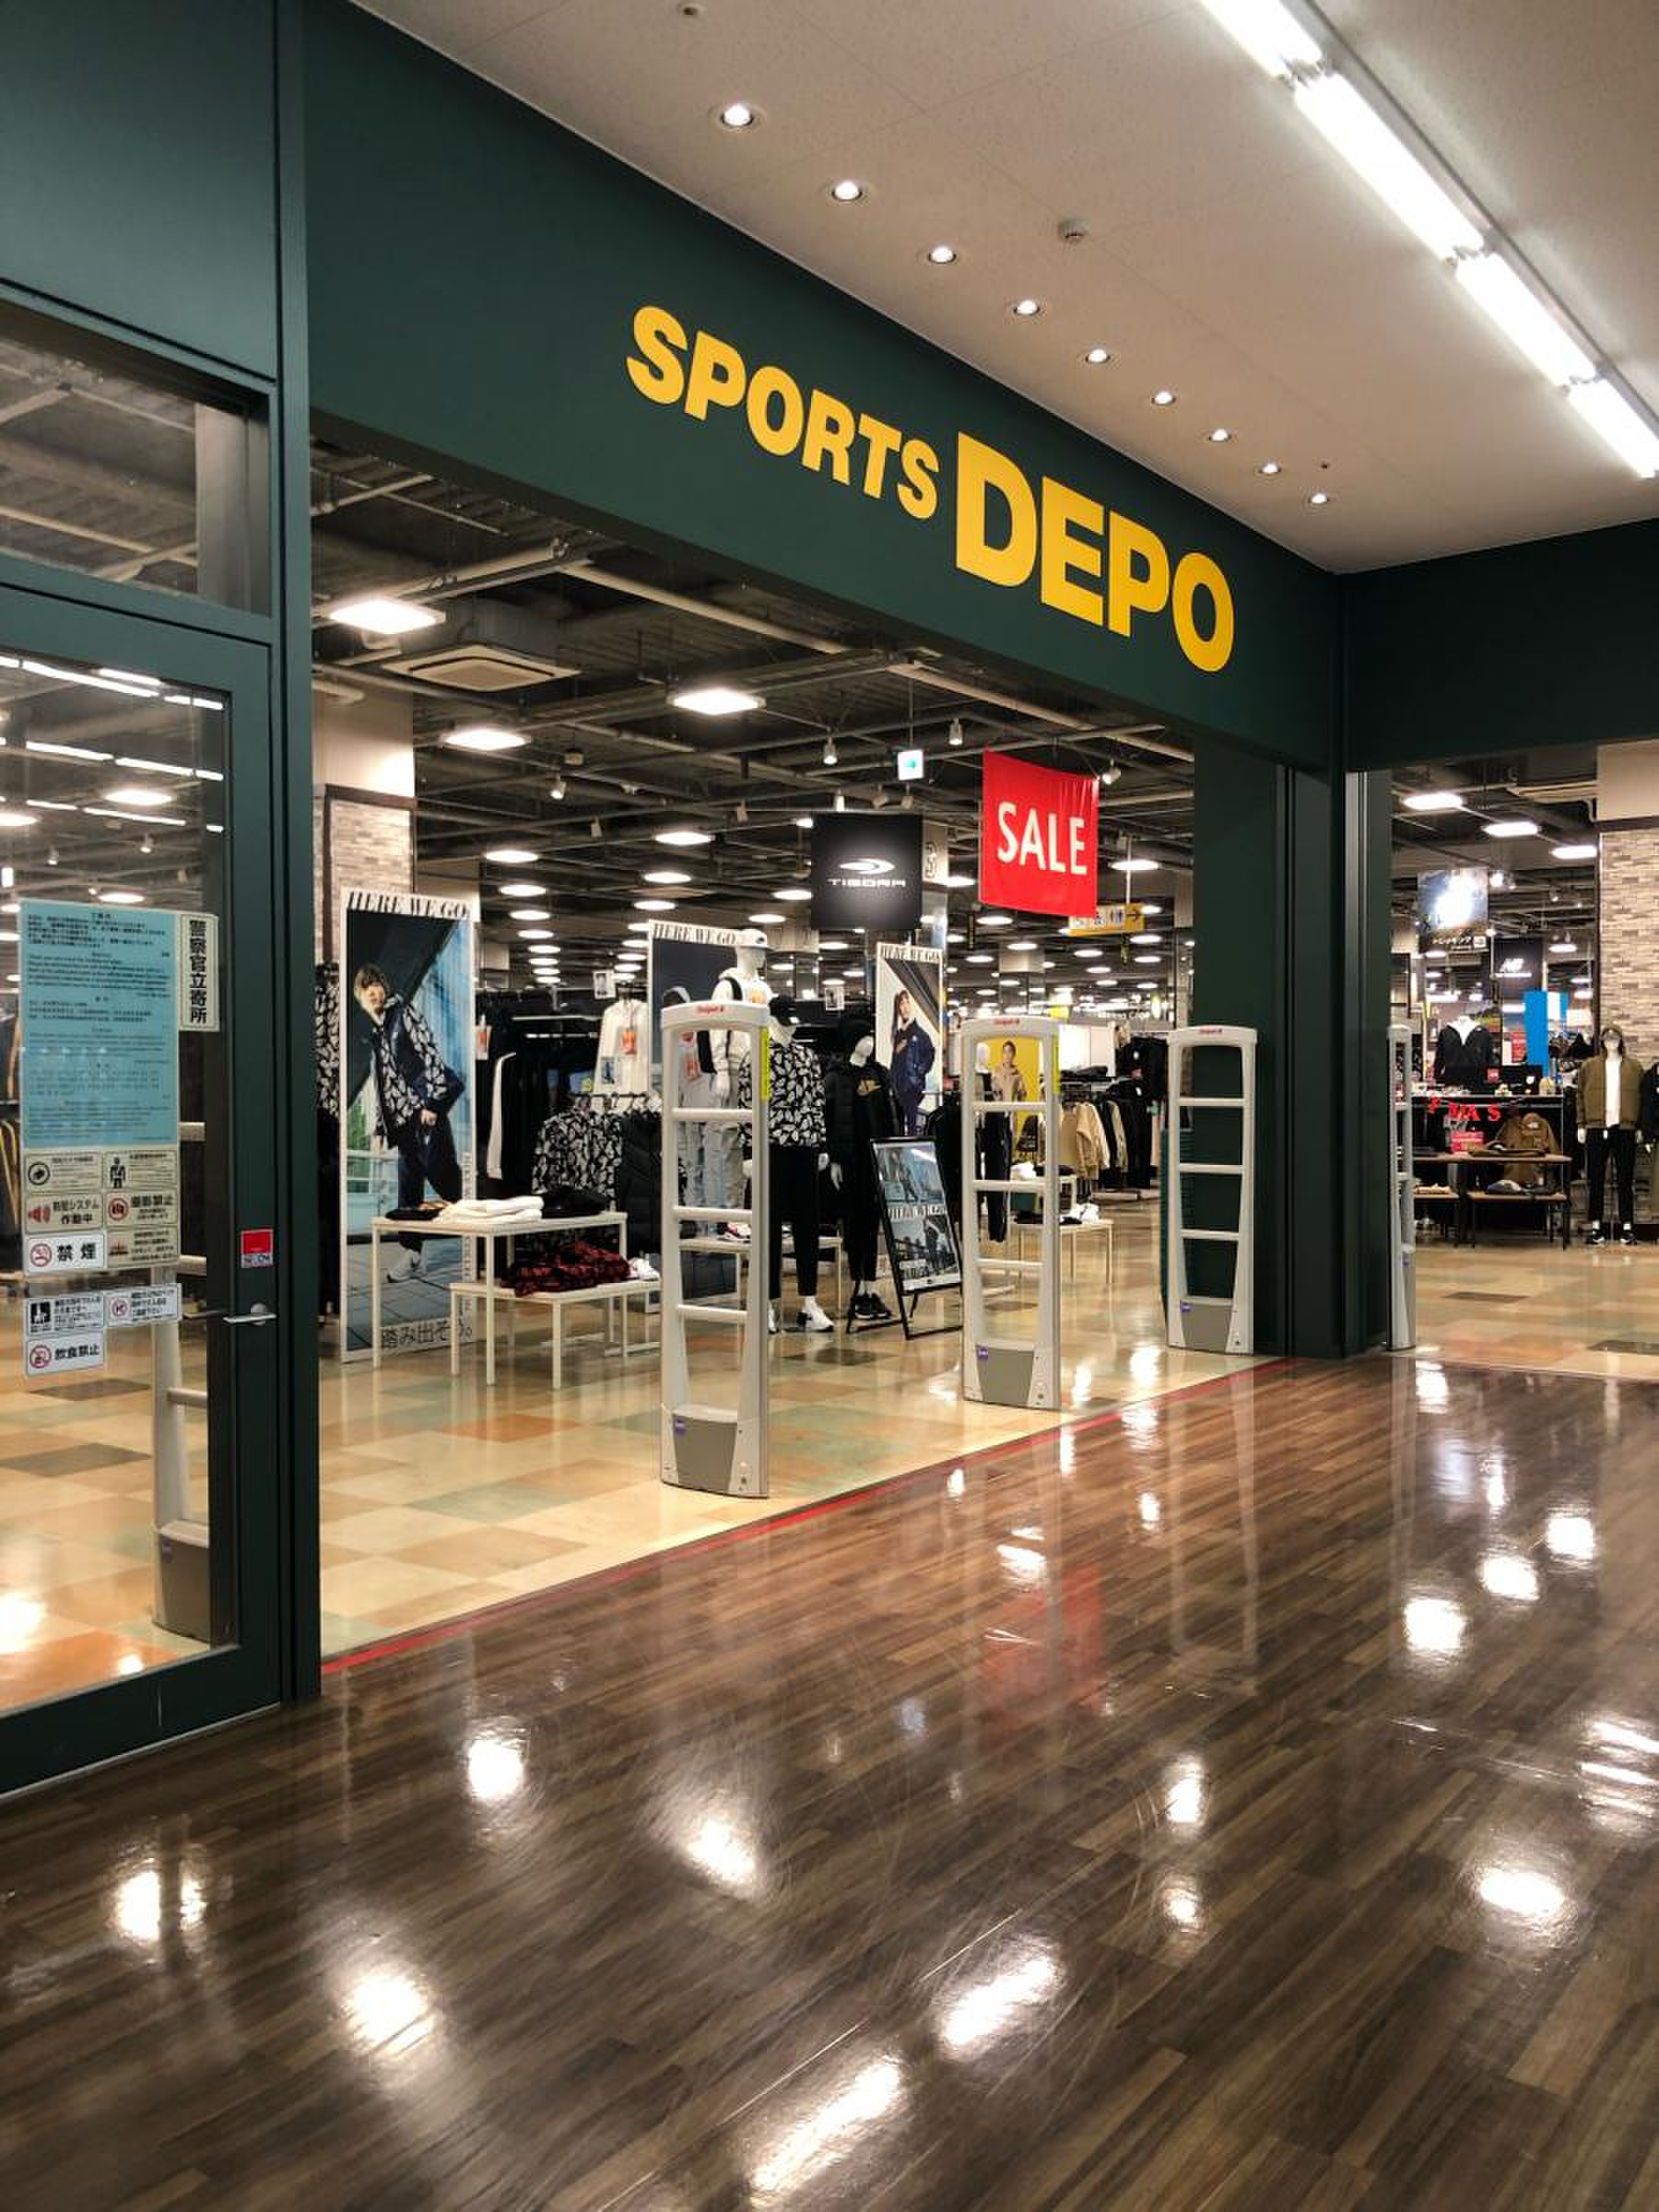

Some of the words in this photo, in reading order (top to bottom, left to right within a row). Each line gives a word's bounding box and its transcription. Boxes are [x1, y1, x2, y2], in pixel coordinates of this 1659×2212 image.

[626, 305, 939, 519] SPORTS
[956, 431, 1234, 672] DEPO
[996, 801, 1088, 875] SALE
[347, 891, 400, 912] HERE
[410, 897, 436, 917] WE
[653, 924, 691, 941] HERE
[695, 927, 715, 944] WE
[190, 920, 206, 1024] 警察官立寄所
